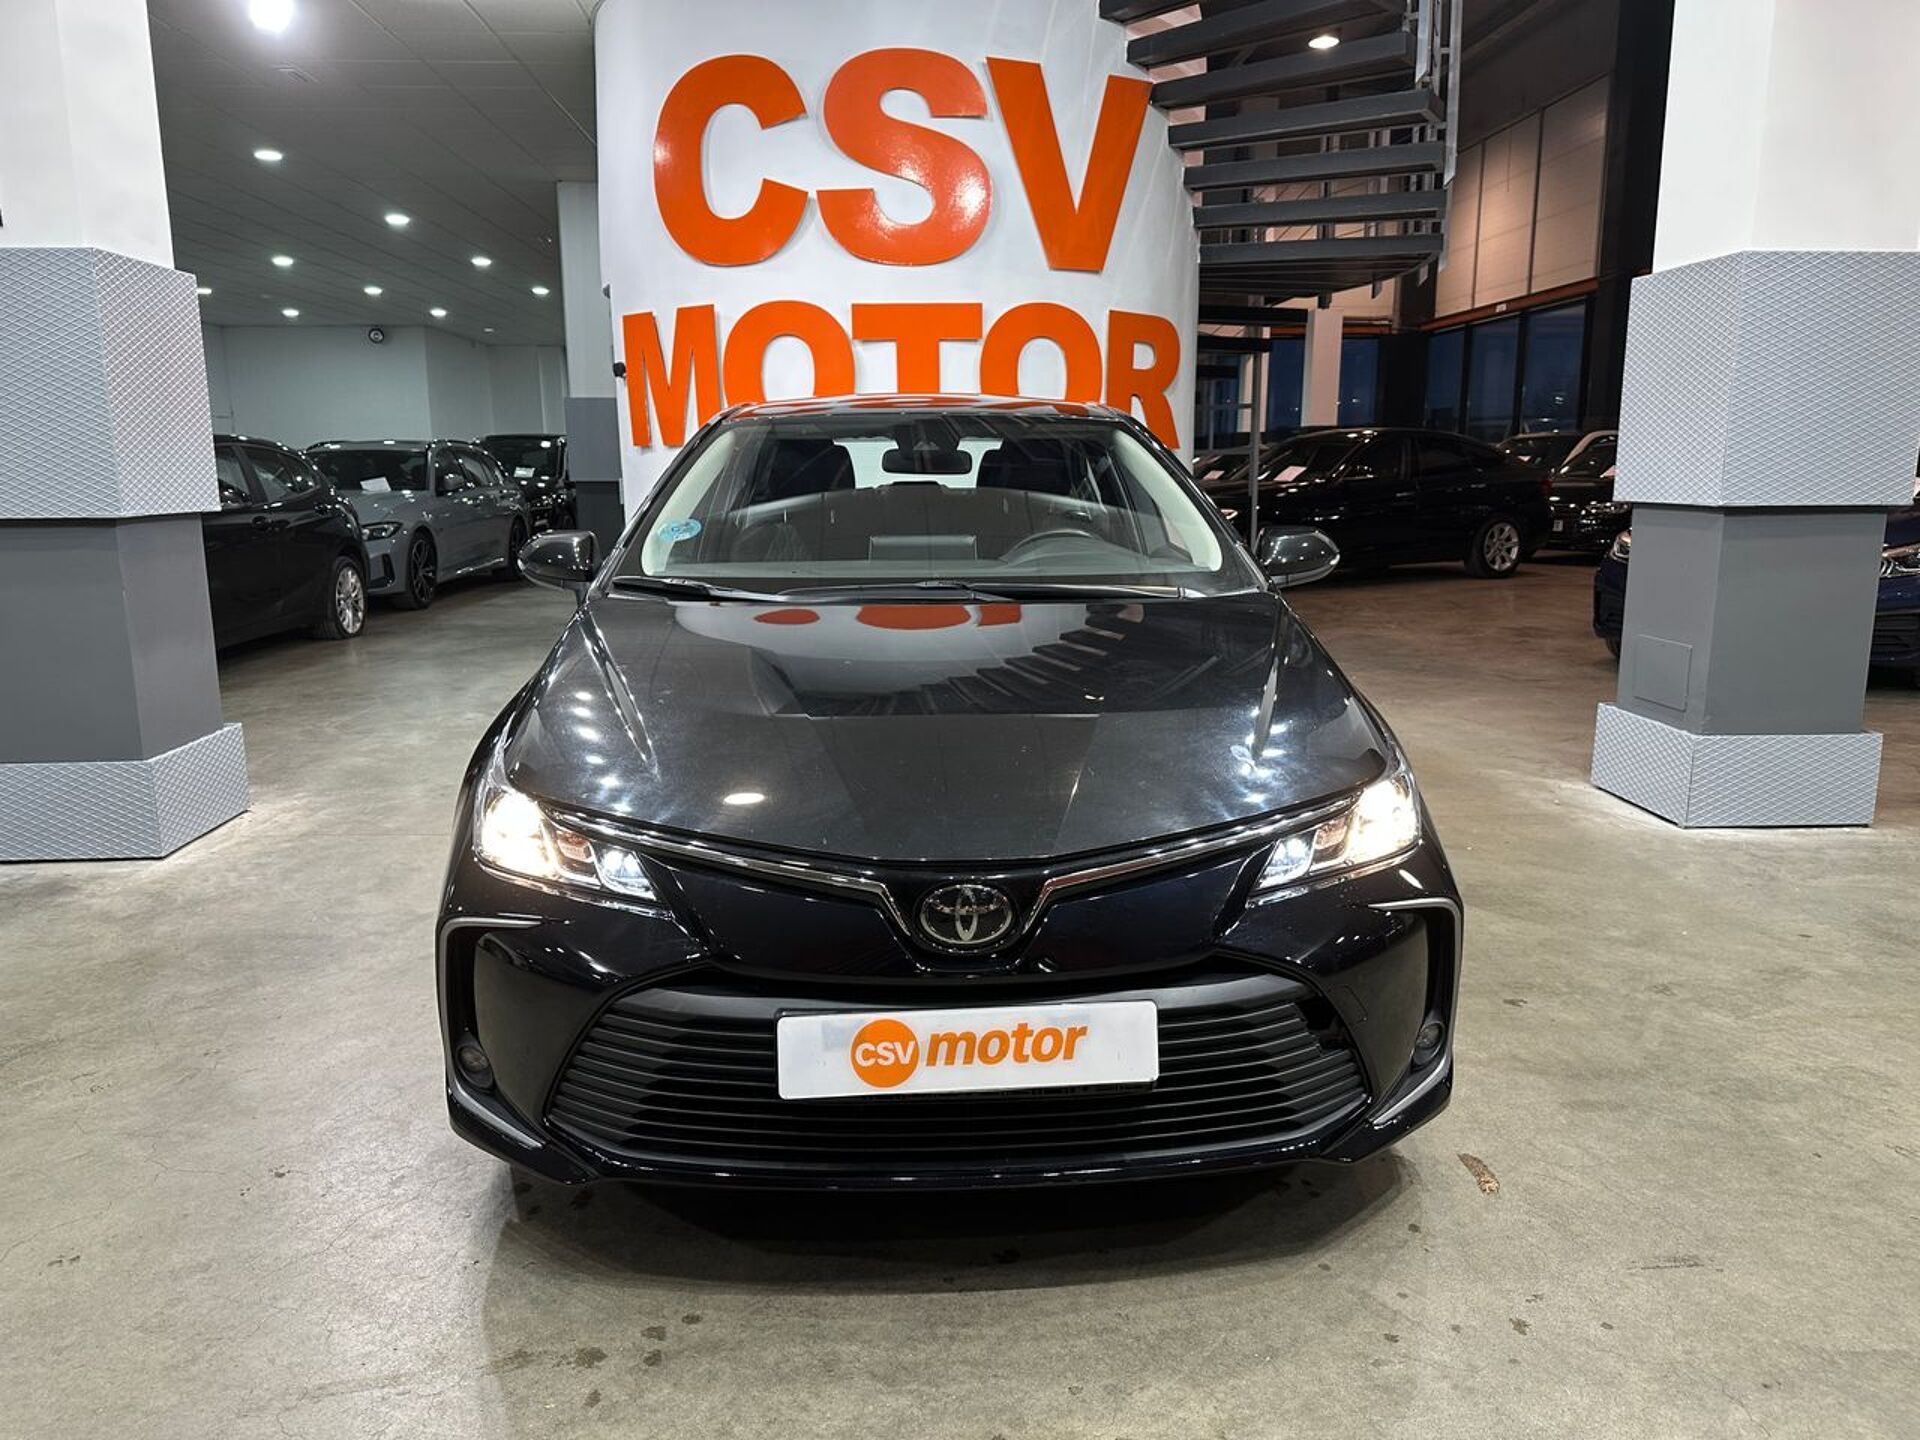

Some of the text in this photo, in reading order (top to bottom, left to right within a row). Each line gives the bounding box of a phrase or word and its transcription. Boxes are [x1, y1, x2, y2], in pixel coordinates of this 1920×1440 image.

[654, 48, 1152, 272] CSV
[623, 300, 1180, 449] MOTOR
[856, 1022, 1088, 1067] CSV motor
